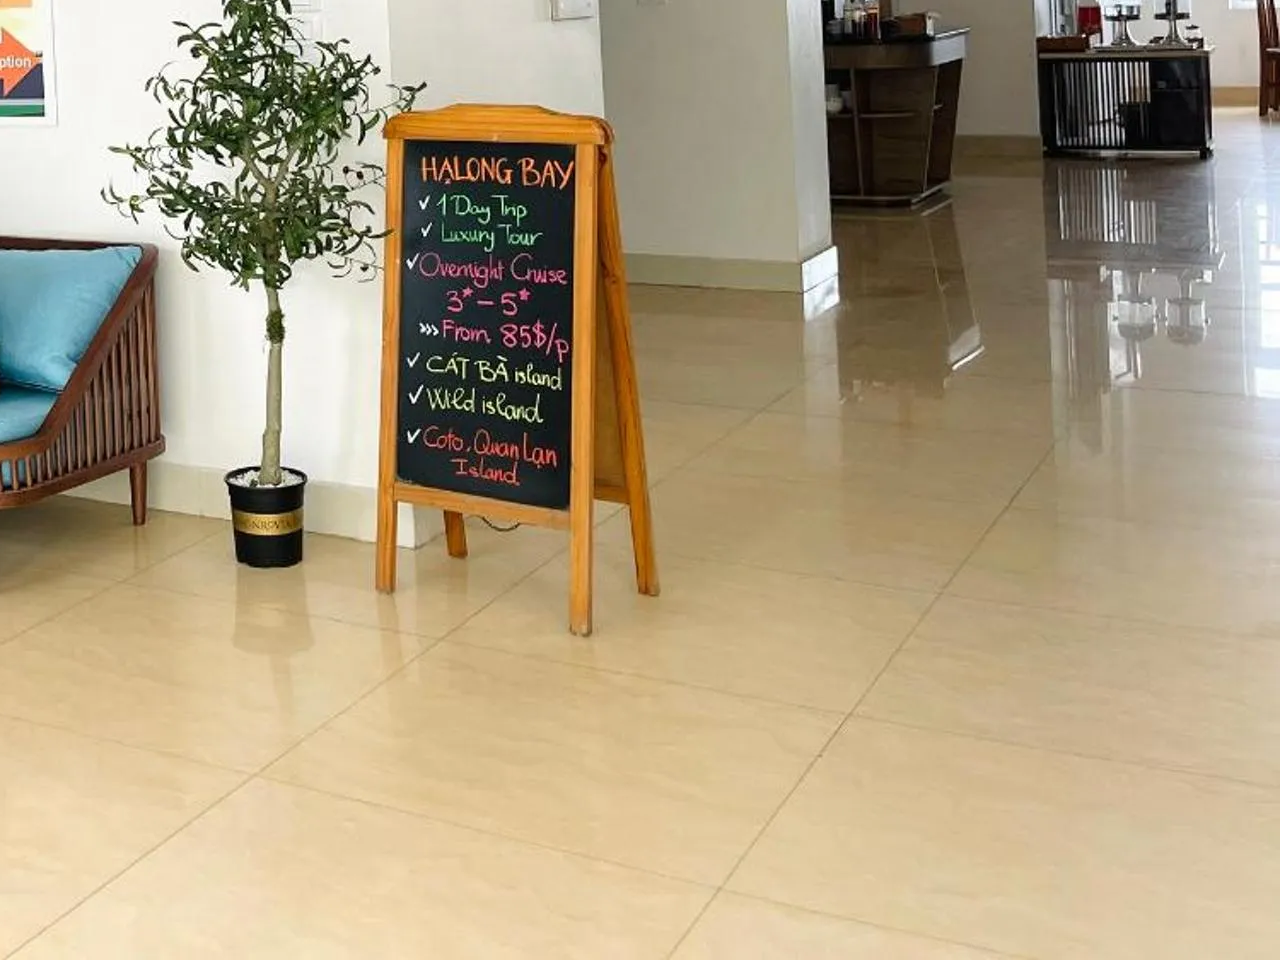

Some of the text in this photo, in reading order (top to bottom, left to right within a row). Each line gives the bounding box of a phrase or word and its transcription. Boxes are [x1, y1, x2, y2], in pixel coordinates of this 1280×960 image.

[517, 157, 574, 189] BAY
[436, 194, 528, 226] 1 Day Trip
[441, 222, 543, 252] Luxury Tour
[419, 253, 567, 288] Overnight Cruise
[515, 362, 562, 390] island
[426, 386, 543, 423] Wild island
[474, 429, 519, 460] Quan
